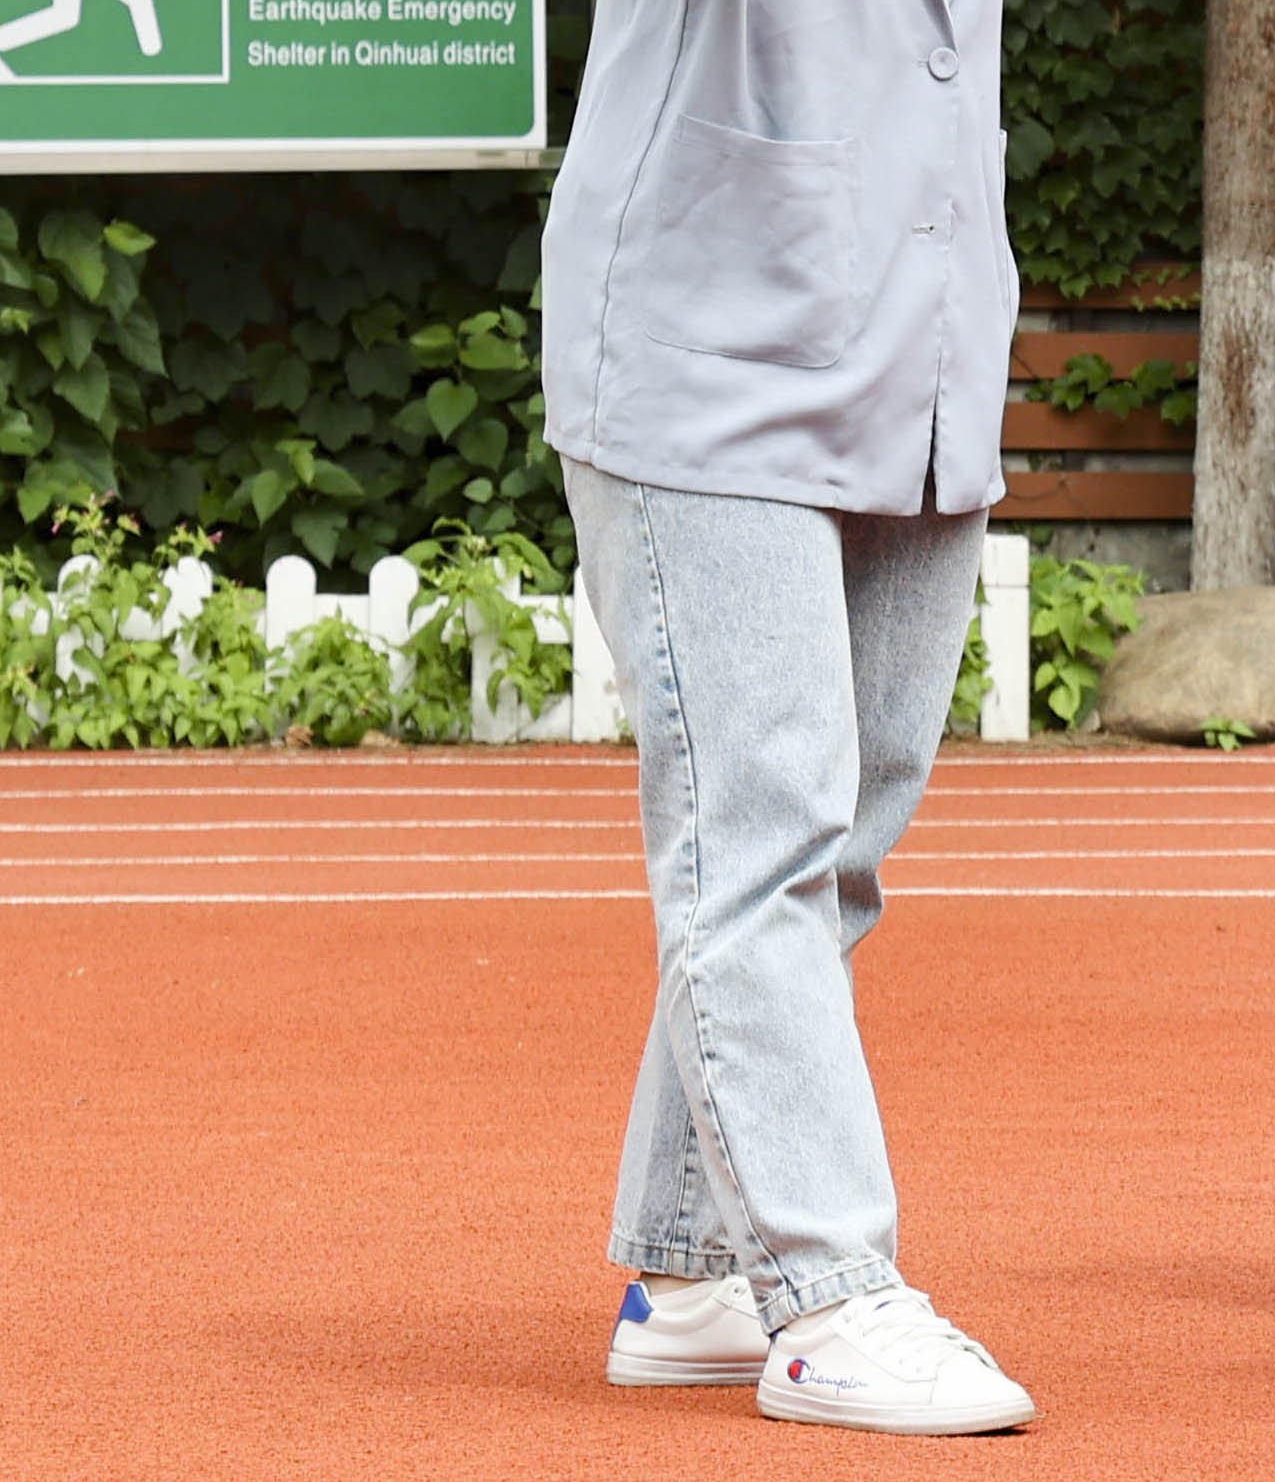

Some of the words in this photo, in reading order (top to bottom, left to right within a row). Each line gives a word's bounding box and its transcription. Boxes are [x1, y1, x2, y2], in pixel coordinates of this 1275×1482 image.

[248, 40, 327, 66] Shelter
[331, 41, 350, 66] in
[355, 40, 439, 66] Qinhuai
[443, 40, 516, 66] district
